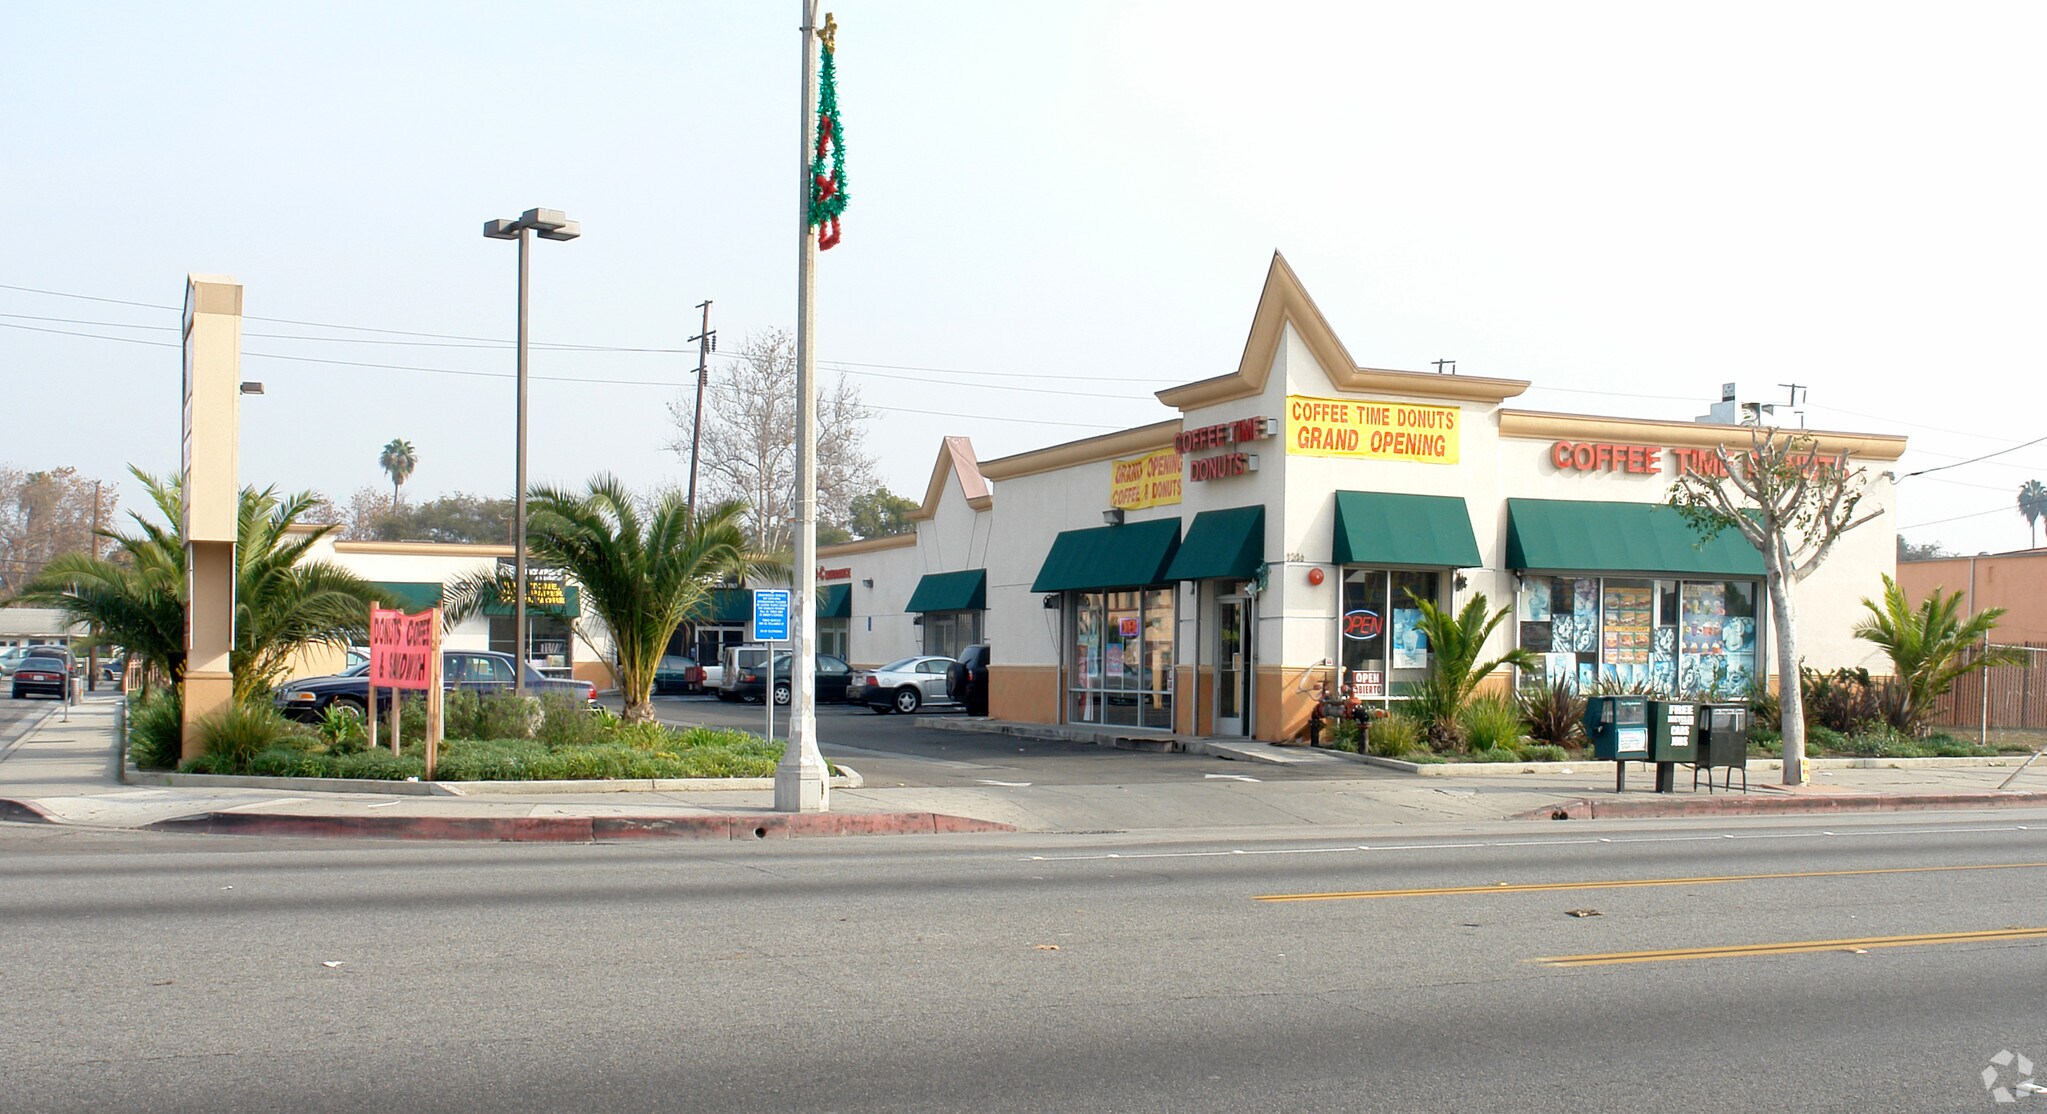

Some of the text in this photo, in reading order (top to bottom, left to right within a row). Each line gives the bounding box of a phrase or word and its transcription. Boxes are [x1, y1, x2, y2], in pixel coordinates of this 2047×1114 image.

[1292, 401, 1454, 430] COFFEE TIME DONUTS
[1174, 416, 1265, 453] COFFEE TIME
[1297, 426, 1446, 457] GRAND OPENING
[1115, 454, 1182, 484] GRAND OPENING
[1190, 452, 1246, 482] DONUTS
[1551, 440, 1662, 474] COFFEE
[1671, 448, 1736, 478] TIME
[1112, 479, 1182, 505] COFFEE & DONUTS
[374, 617, 402, 645] DONUTS
[1343, 615, 1384, 635] OPEN
[1355, 672, 1380, 684] OPEN
[1668, 704, 1694, 715] FREE
[1670, 725, 1690, 736] CARS
